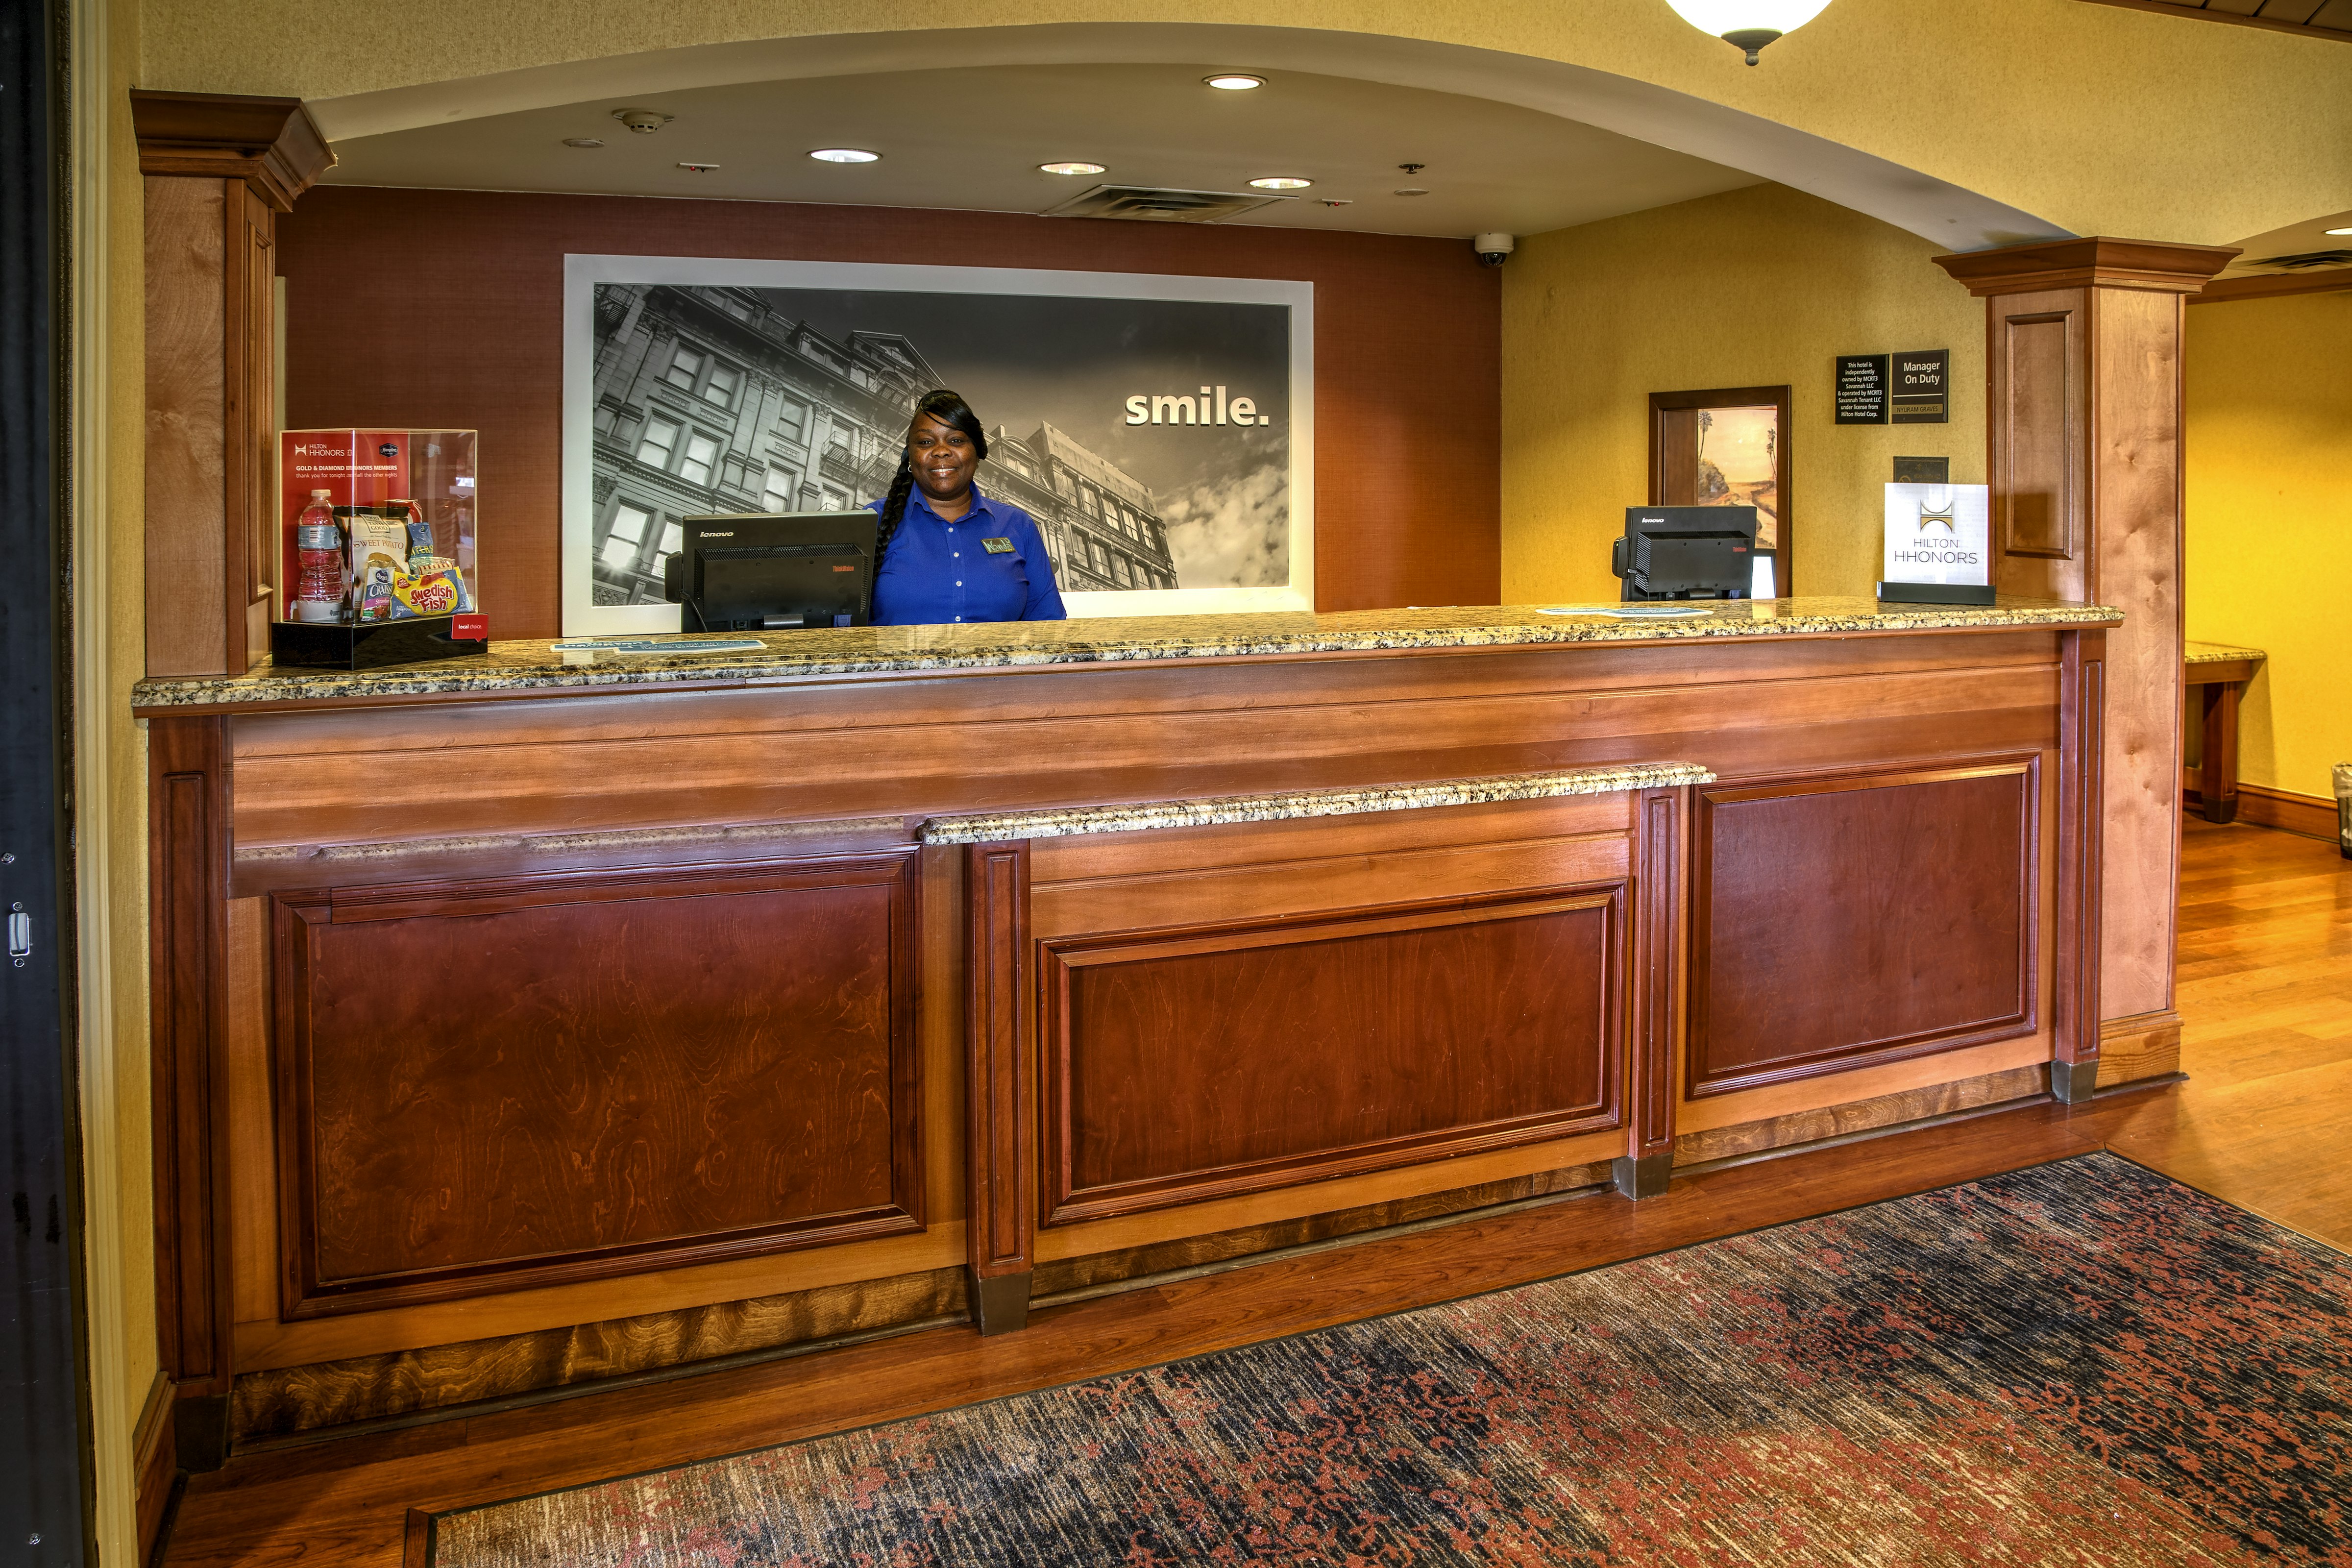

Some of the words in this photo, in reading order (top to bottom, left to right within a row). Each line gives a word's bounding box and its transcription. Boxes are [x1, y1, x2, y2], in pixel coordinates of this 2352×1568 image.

[1903, 362, 1940, 372] Manager
[1905, 375, 1917, 384] On
[1920, 374, 1940, 385] Duty
[1125, 386, 1269, 427] smile.
[383, 539, 404, 549] POTATO
[982, 539, 1013, 552] Wanda
[1914, 539, 1959, 548] HILTON
[1895, 550, 1978, 564] HHONORS
[410, 584, 453, 606] Swedish
[419, 596, 447, 612] Fish
